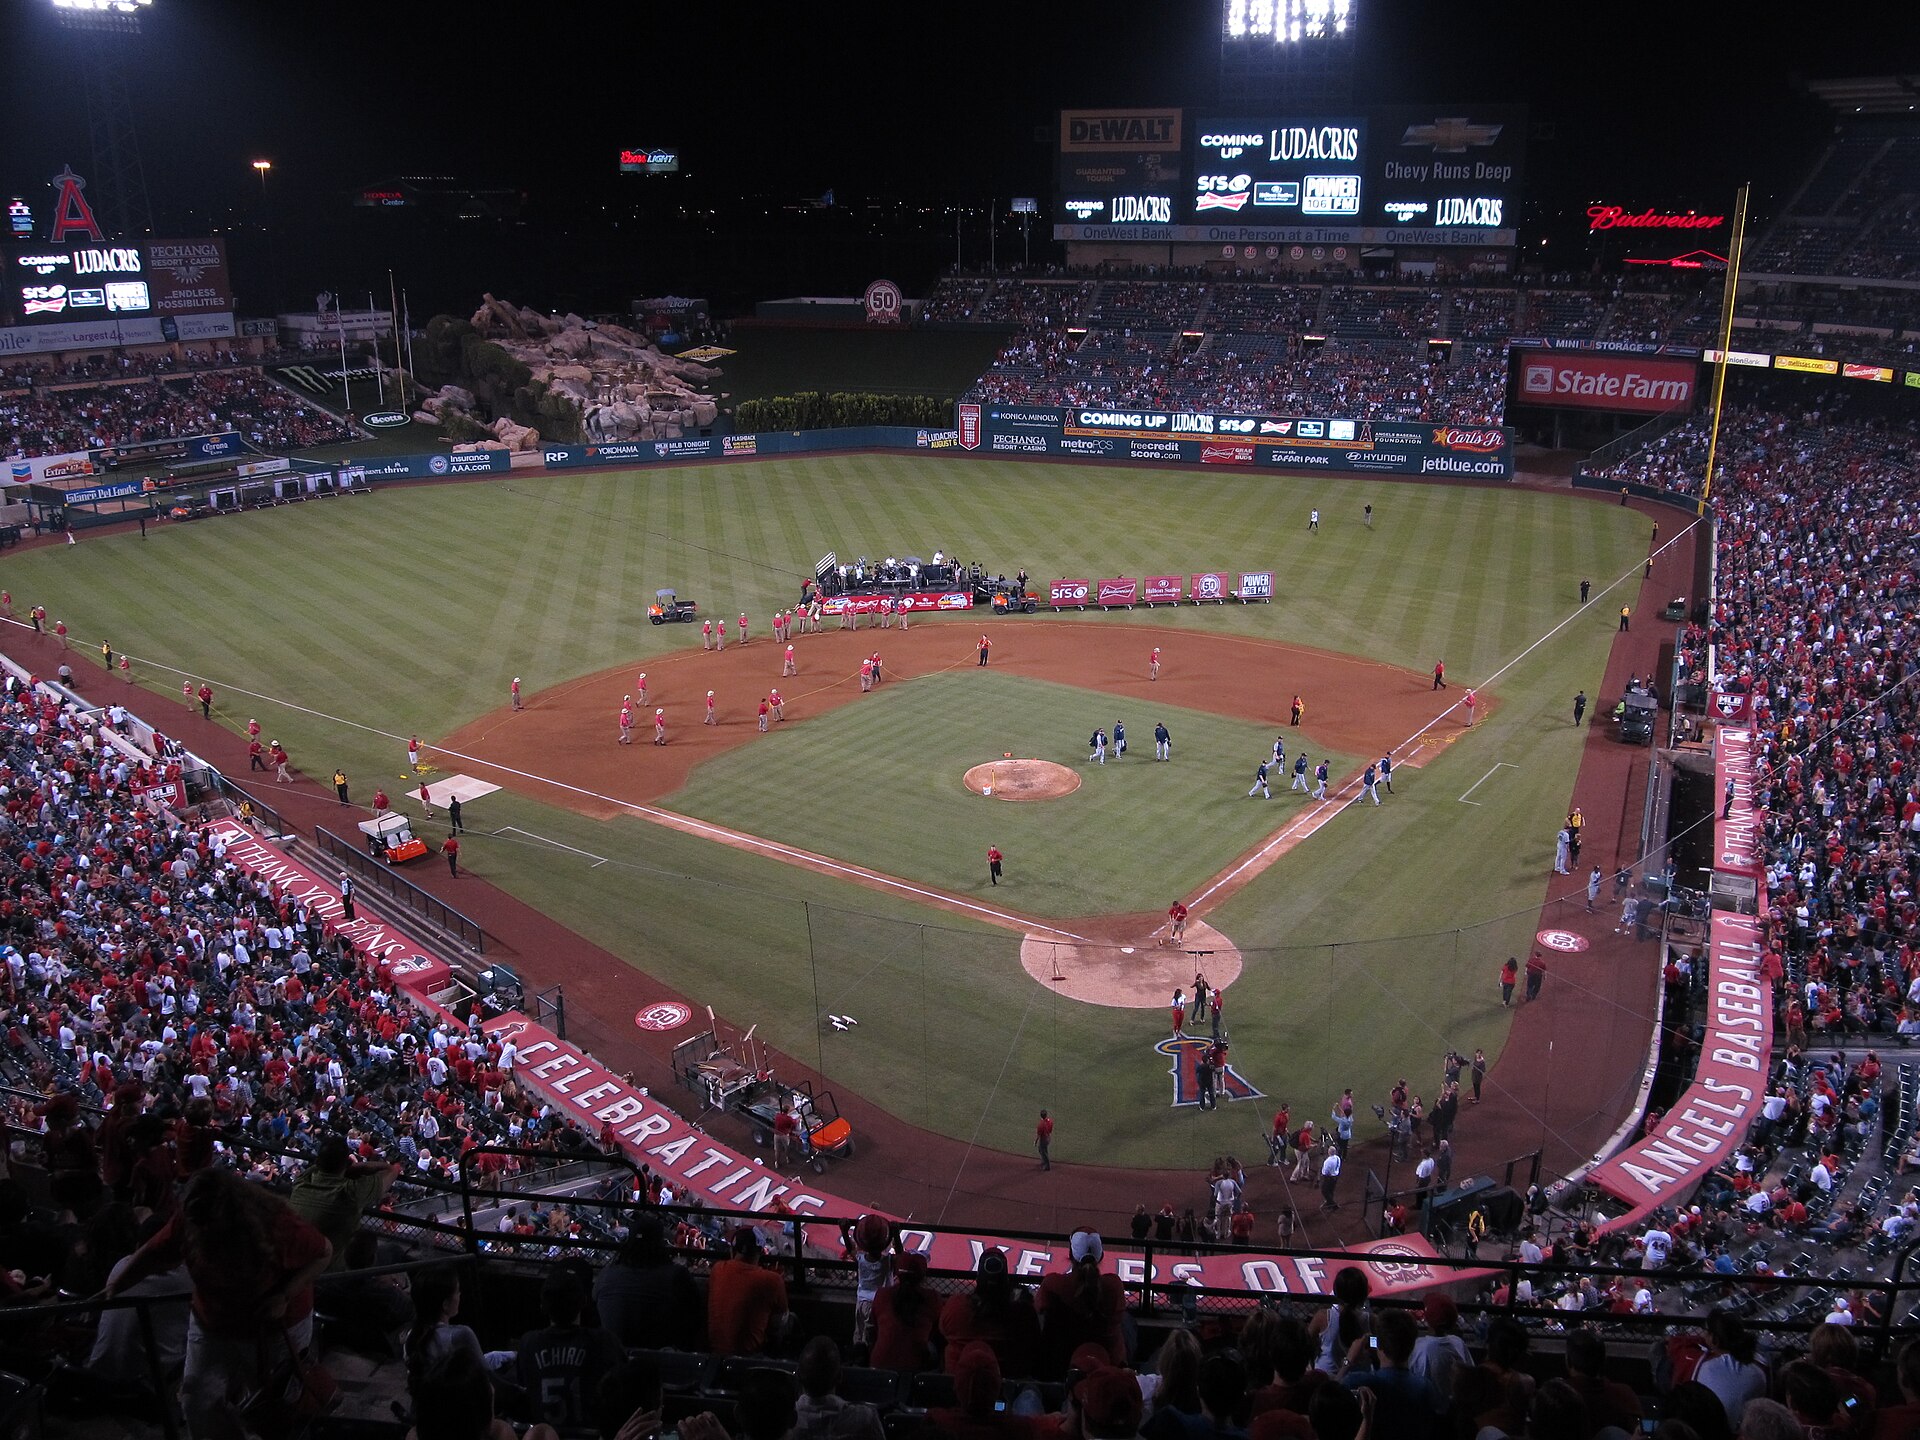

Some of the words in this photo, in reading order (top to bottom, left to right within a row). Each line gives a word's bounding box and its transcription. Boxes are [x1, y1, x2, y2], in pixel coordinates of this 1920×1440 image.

[1200, 135, 1264, 147] COMING
[1269, 127, 1358, 161] LUDACRIS
[621, 151, 646, 164] Coors
[647, 153, 675, 163] LIGHT
[1220, 147, 1243, 159] UP
[1076, 168, 1126, 176] GUARANTEED
[1384, 162, 1429, 182] Chevy
[1433, 162, 1471, 180] Runs
[1475, 162, 1512, 182] Deep
[1306, 178, 1357, 197] POWER
[1065, 201, 1104, 211] COMING
[1111, 196, 1171, 223] LUDACRIS
[1308, 199, 1327, 209] 106
[1333, 198, 1356, 209] FM
[1384, 203, 1428, 213] COMING
[1077, 210, 1092, 219] UP
[1397, 212, 1414, 222] UP
[1435, 197, 1503, 226] LUDACRIS
[1586, 206, 1724, 230] Budweiser
[1083, 226, 1138, 240] OneWest
[1142, 227, 1172, 241] Bank
[1209, 228, 1236, 240] One
[1239, 229, 1287, 241] Person
[1288, 230, 1300, 241] at
[1305, 232, 1313, 242] a
[1314, 229, 1350, 242] Time
[1386, 229, 1448, 243] OneWest
[1451, 230, 1486, 244] Bank
[150, 245, 219, 257] PECHANGA
[19, 255, 70, 266] COMING
[73, 248, 141, 275] LUDACRIS
[36, 265, 56, 274] UP
[157, 298, 225, 309] POSSIBILITIES
[872, 291, 894, 309] 50
[73, 331, 108, 342] Largest
[1556, 339, 1580, 348] MINI
[1000, 412, 1027, 421] KONICA
[1028, 414, 1059, 422] MINOLTA
[1080, 412, 1142, 426] COMING
[1145, 415, 1166, 427] UP
[1171, 414, 1213, 433] LUDACRIS
[928, 431, 958, 442] LUDACRIS
[993, 434, 1047, 446] PECHANGA
[202, 443, 228, 452] Corona
[684, 440, 711, 448] TONIGHT
[931, 440, 952, 448] AUGUST
[1061, 439, 1114, 450] metroPCS
[1130, 441, 1179, 451] freecredit
[598, 446, 639, 455] YOKOHAMA
[1130, 450, 1181, 460] score.com
[450, 455, 490, 463] Insurance
[1271, 454, 1304, 463] SAFARI
[1363, 453, 1406, 462] HYUNDAI
[384, 465, 409, 474] thrive
[451, 463, 491, 473] AAA.com
[1420, 456, 1504, 474] jetblue.com
[113, 484, 137, 496] Foods
[1203, 580, 1216, 590] 50
[1243, 574, 1269, 587] POWER
[1243, 587, 1255, 595] 106
[1258, 586, 1269, 594] FM
[1718, 694, 1742, 706] MLB
[1724, 748, 1752, 776] FANS
[149, 784, 175, 799] MLB
[1724, 807, 1755, 849] THANK
[234, 841, 310, 893] THANK
[334, 914, 406, 960] FANS
[1553, 934, 1573, 948] 50
[1618, 1076, 1753, 1195] ANGELS
[1710, 939, 1763, 1072] BASEBALL
[1582, 1190, 1598, 1202] 72
[534, 1346, 587, 1370] ICHIRO
